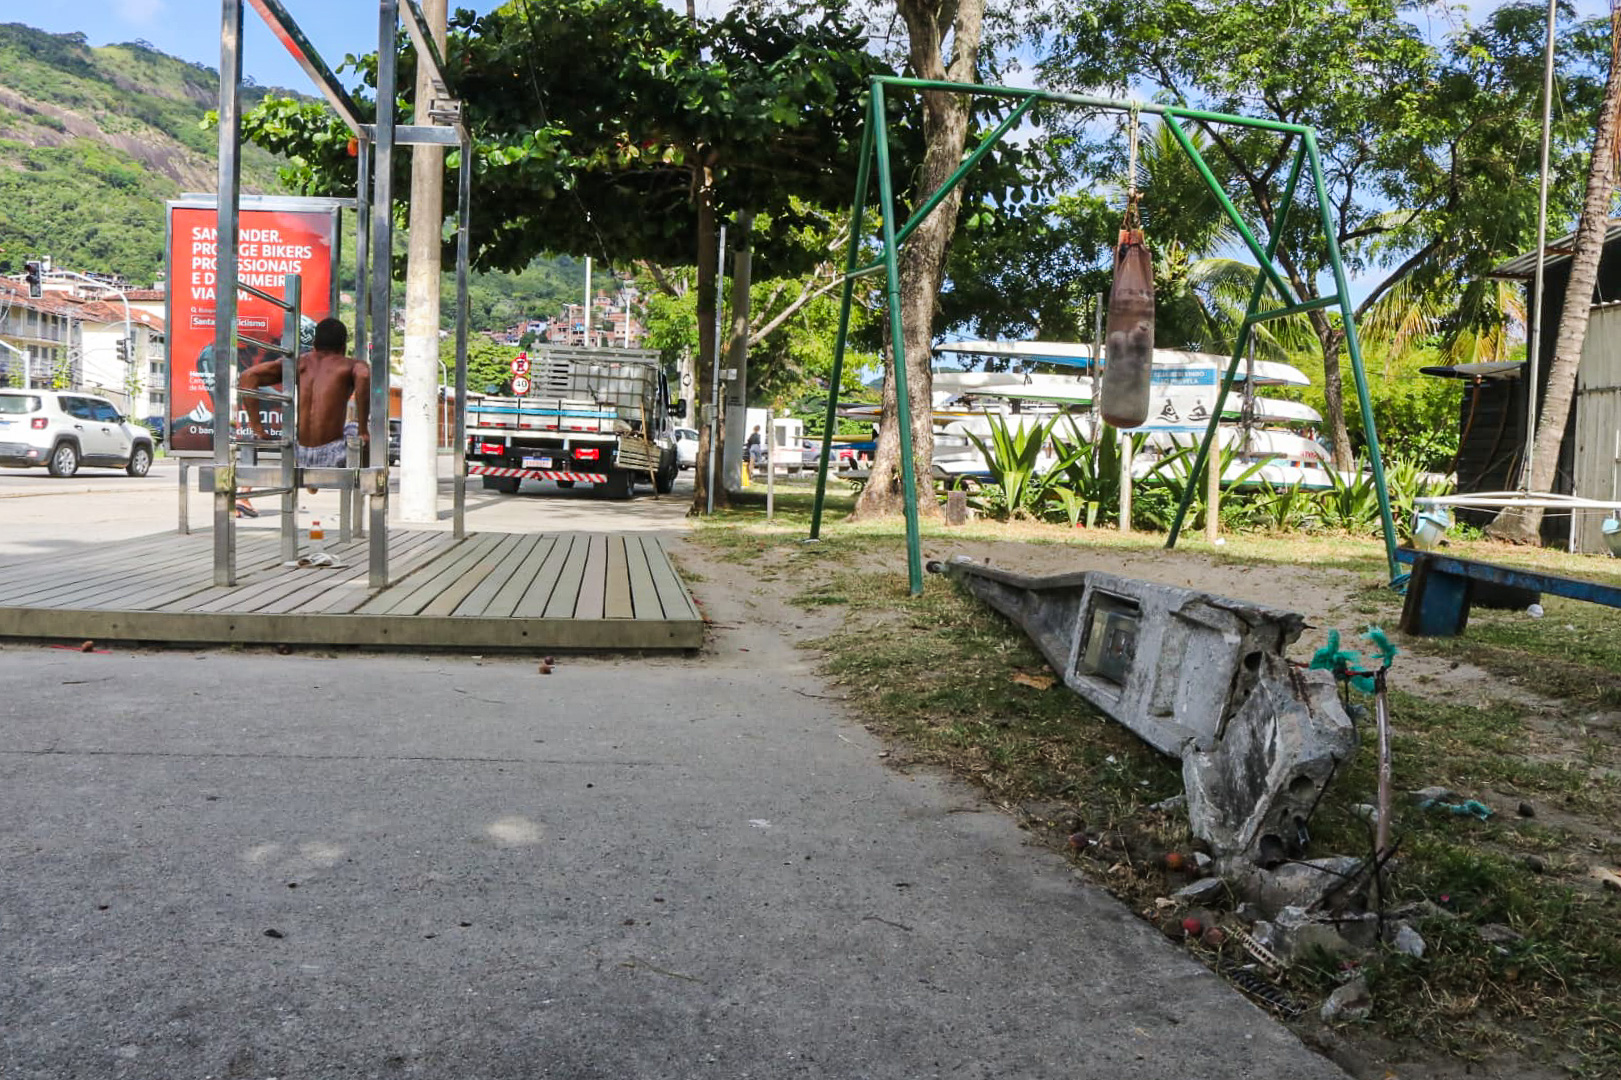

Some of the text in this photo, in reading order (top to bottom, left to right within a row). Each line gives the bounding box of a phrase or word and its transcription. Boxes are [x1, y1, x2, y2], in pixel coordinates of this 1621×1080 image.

[191, 227, 283, 243] SANNDER.
[191, 241, 313, 259] PROGE BIKERS
[191, 256, 302, 273] PROSSIONAIS
[191, 272, 201, 285] E
[237, 273, 286, 287] RIMEIR
[191, 287, 253, 301] VIAM.
[515, 379, 528, 388] 40
[190, 425, 197, 434] O
